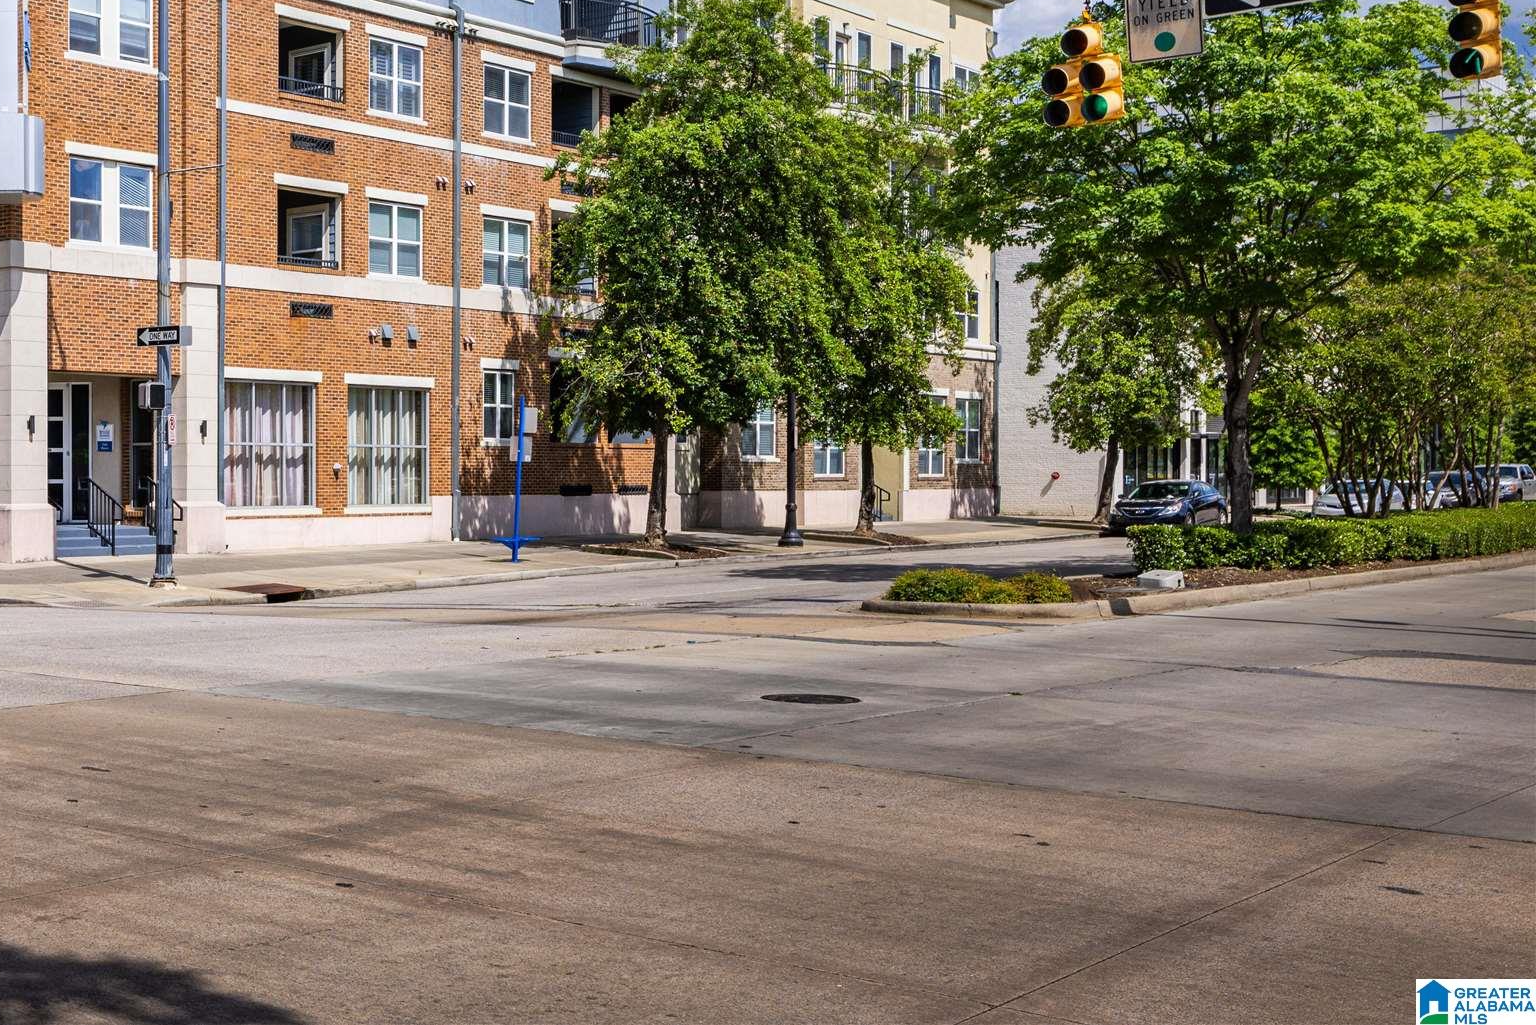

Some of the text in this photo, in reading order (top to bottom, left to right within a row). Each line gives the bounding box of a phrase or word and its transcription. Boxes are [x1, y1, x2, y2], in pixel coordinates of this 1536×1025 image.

[1133, 8, 1195, 26] ON GREEN
[149, 330, 176, 340] ONE WAY
